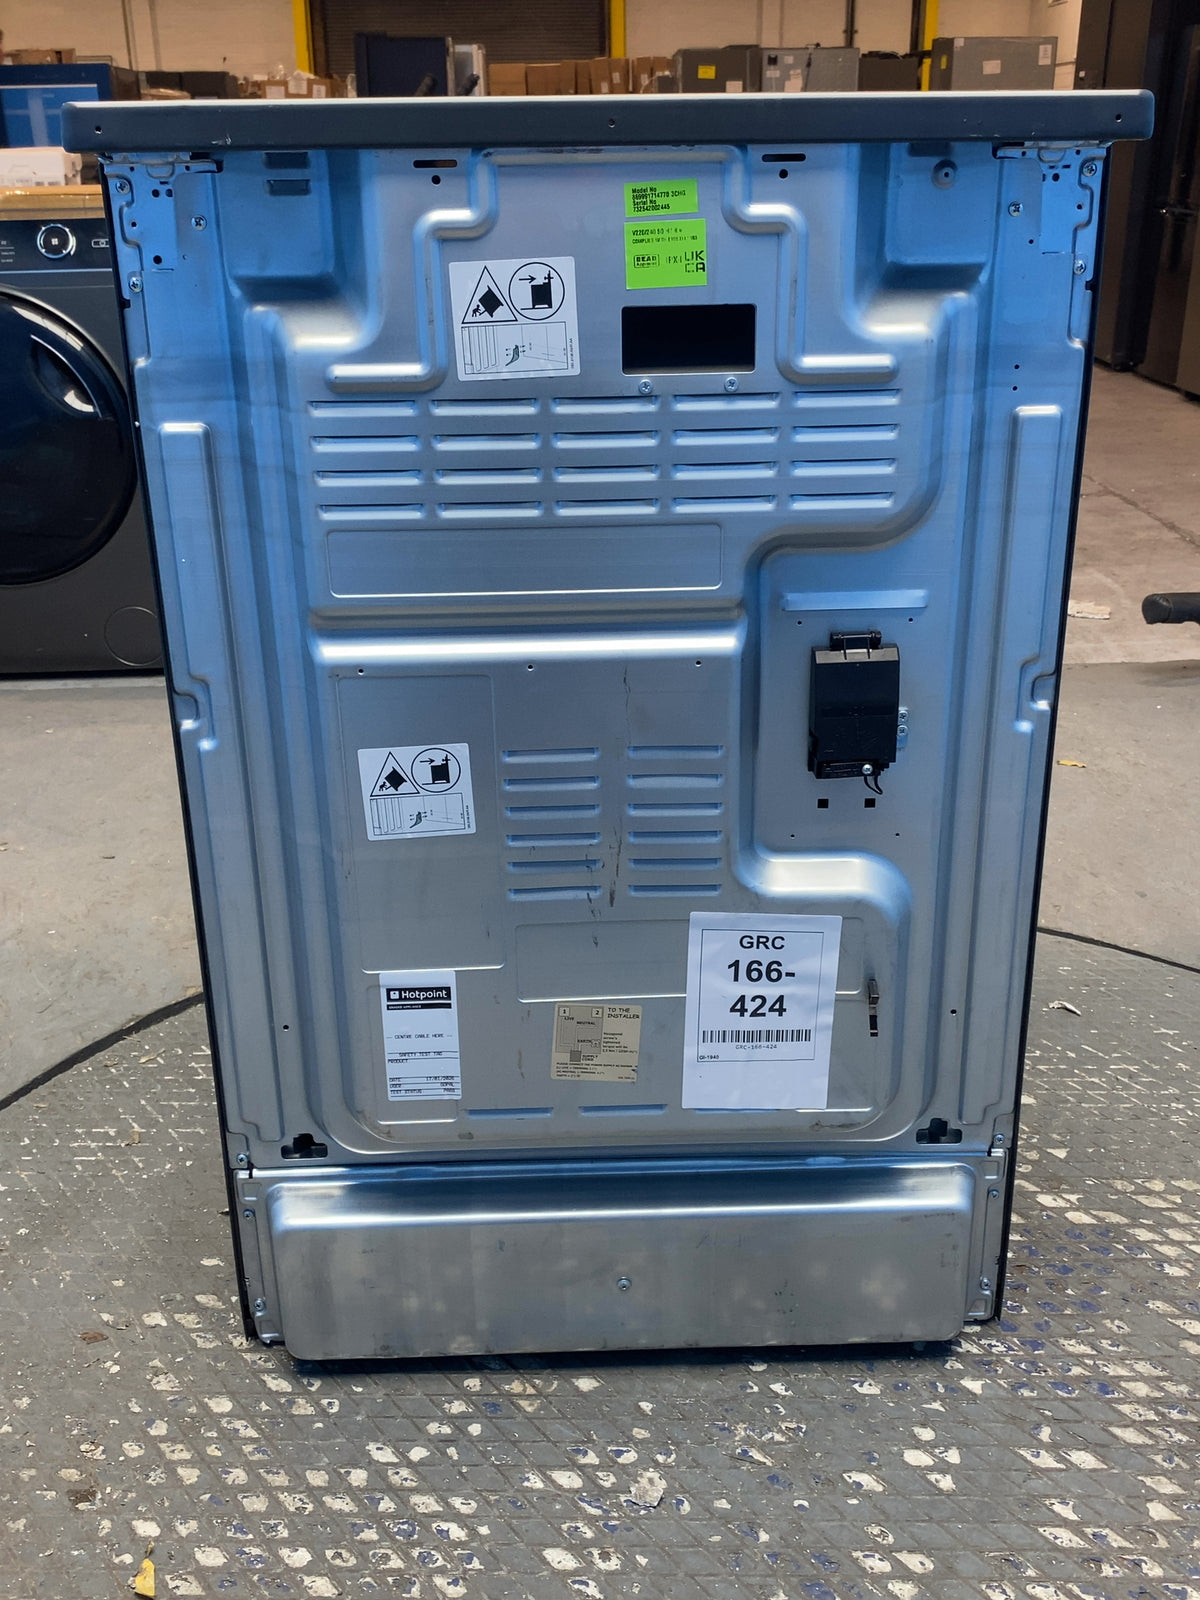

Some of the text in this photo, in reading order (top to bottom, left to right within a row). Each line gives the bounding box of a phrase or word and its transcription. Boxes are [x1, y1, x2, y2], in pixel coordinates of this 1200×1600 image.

[684, 250, 705, 262] UK
[684, 262, 706, 273] CA
[739, 935, 785, 950] GRC
[728, 960, 796, 982] 166-
[402, 990, 448, 1000] Hotpoint
[729, 994, 787, 1018] 424
